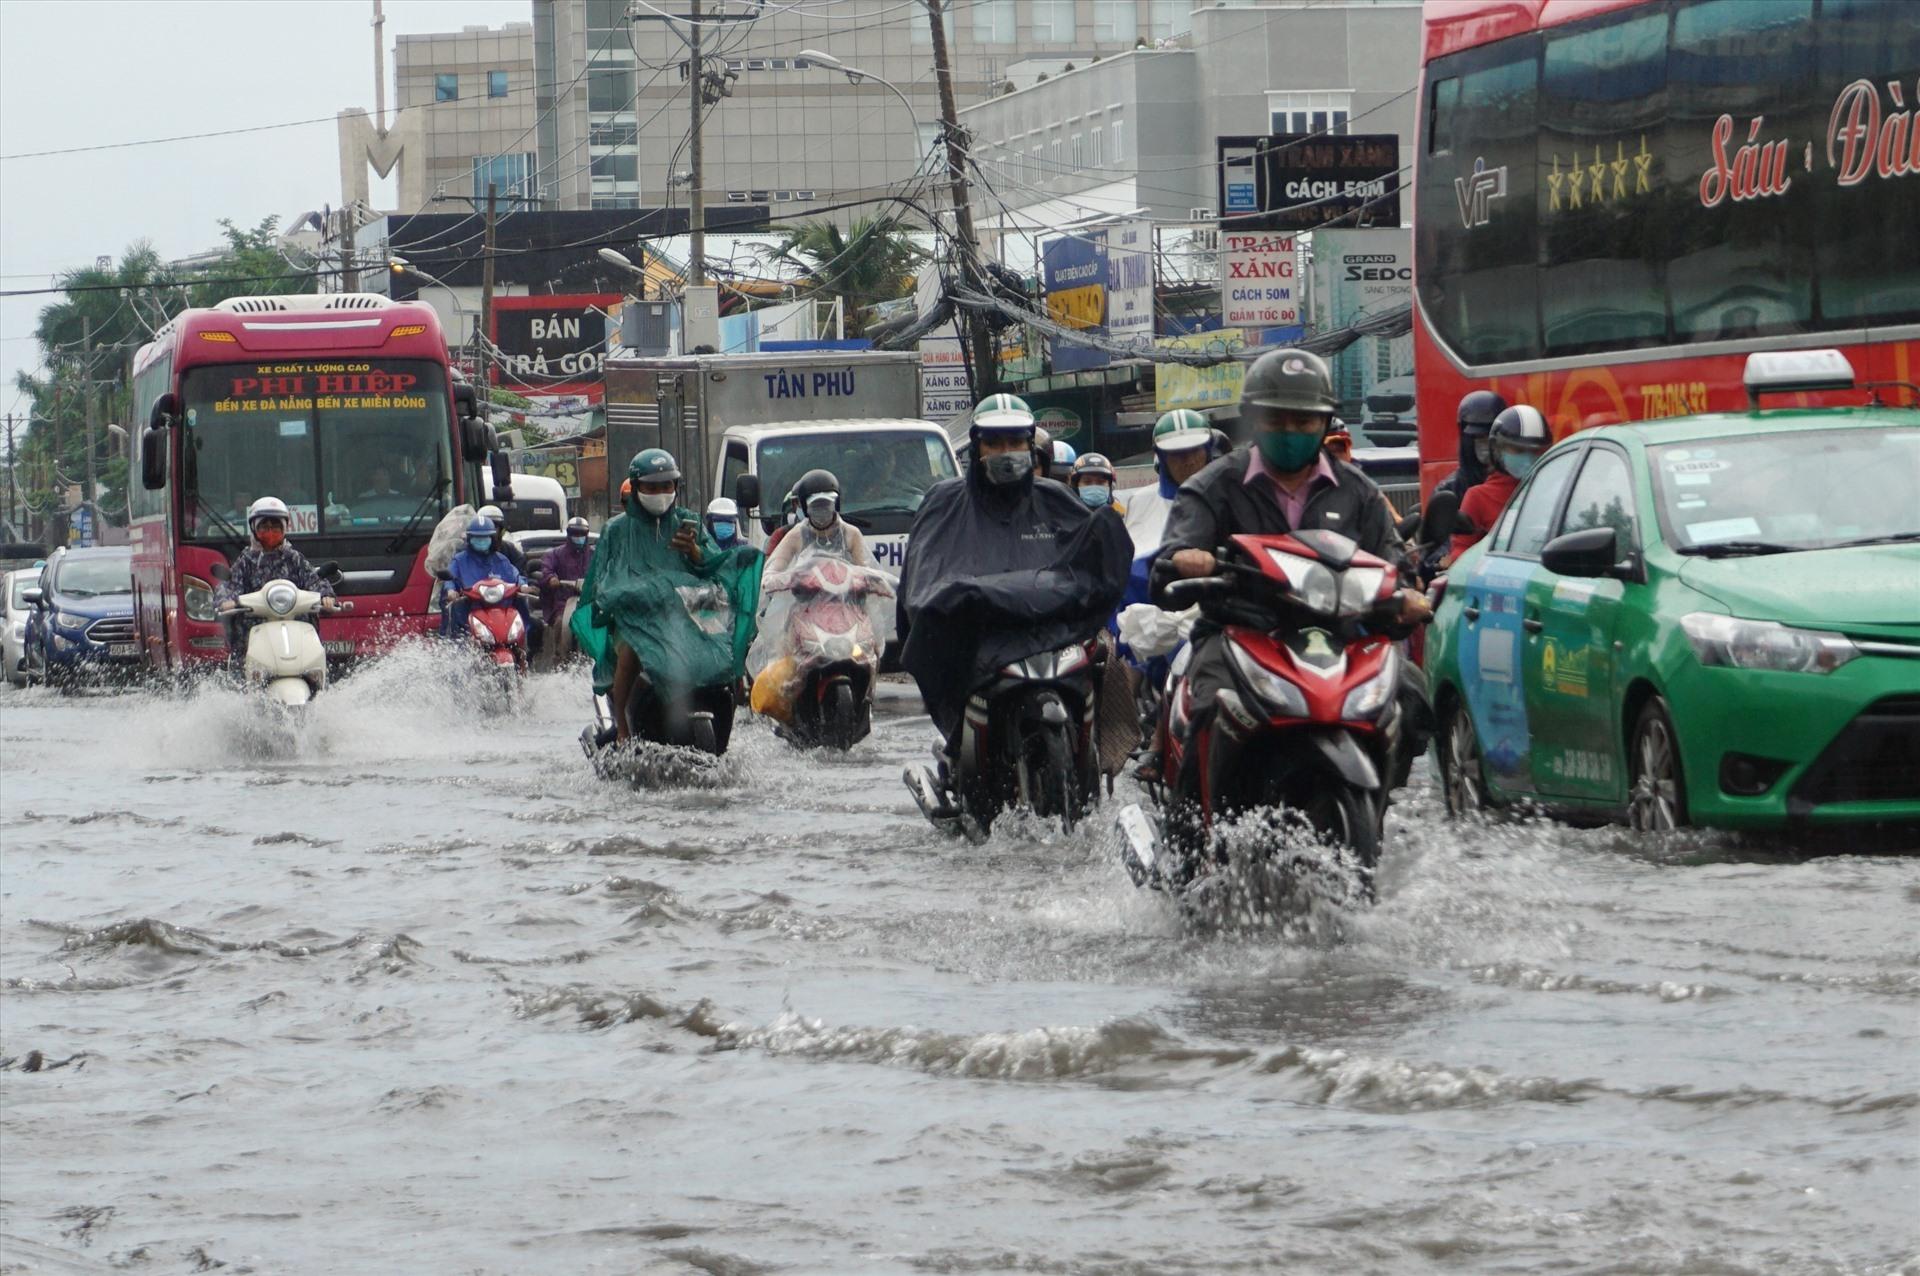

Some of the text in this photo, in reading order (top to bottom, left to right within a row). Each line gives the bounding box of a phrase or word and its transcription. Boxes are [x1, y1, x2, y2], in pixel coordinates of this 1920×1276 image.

[1700, 112, 1793, 208] Sáu
[1285, 177, 1385, 199] CÁCH 50M
[1454, 156, 1507, 229] VIP
[1226, 236, 1295, 257] TRẠM
[1228, 258, 1294, 279] XĂNG
[1345, 255, 1395, 264] GRAND
[1232, 286, 1290, 302] CÁCH 50M
[1259, 305, 1279, 321] TỐC
[531, 313, 580, 340] BÁN
[257, 365, 272, 374] XE
[274, 363, 304, 374] CHẤT
[347, 363, 370, 372] CAO
[505, 347, 550, 375] TRẢ
[231, 369, 418, 397] PHI HIỆP
[764, 366, 856, 399] TÂN PHÚ
[925, 374, 950, 387] XĂNG
[214, 393, 426, 412] BẾN XE ĐÀ NẴNG BẾN XE MIỀN ĐÔNG
[926, 399, 951, 411] XĂNG
[875, 542, 908, 567] PH
